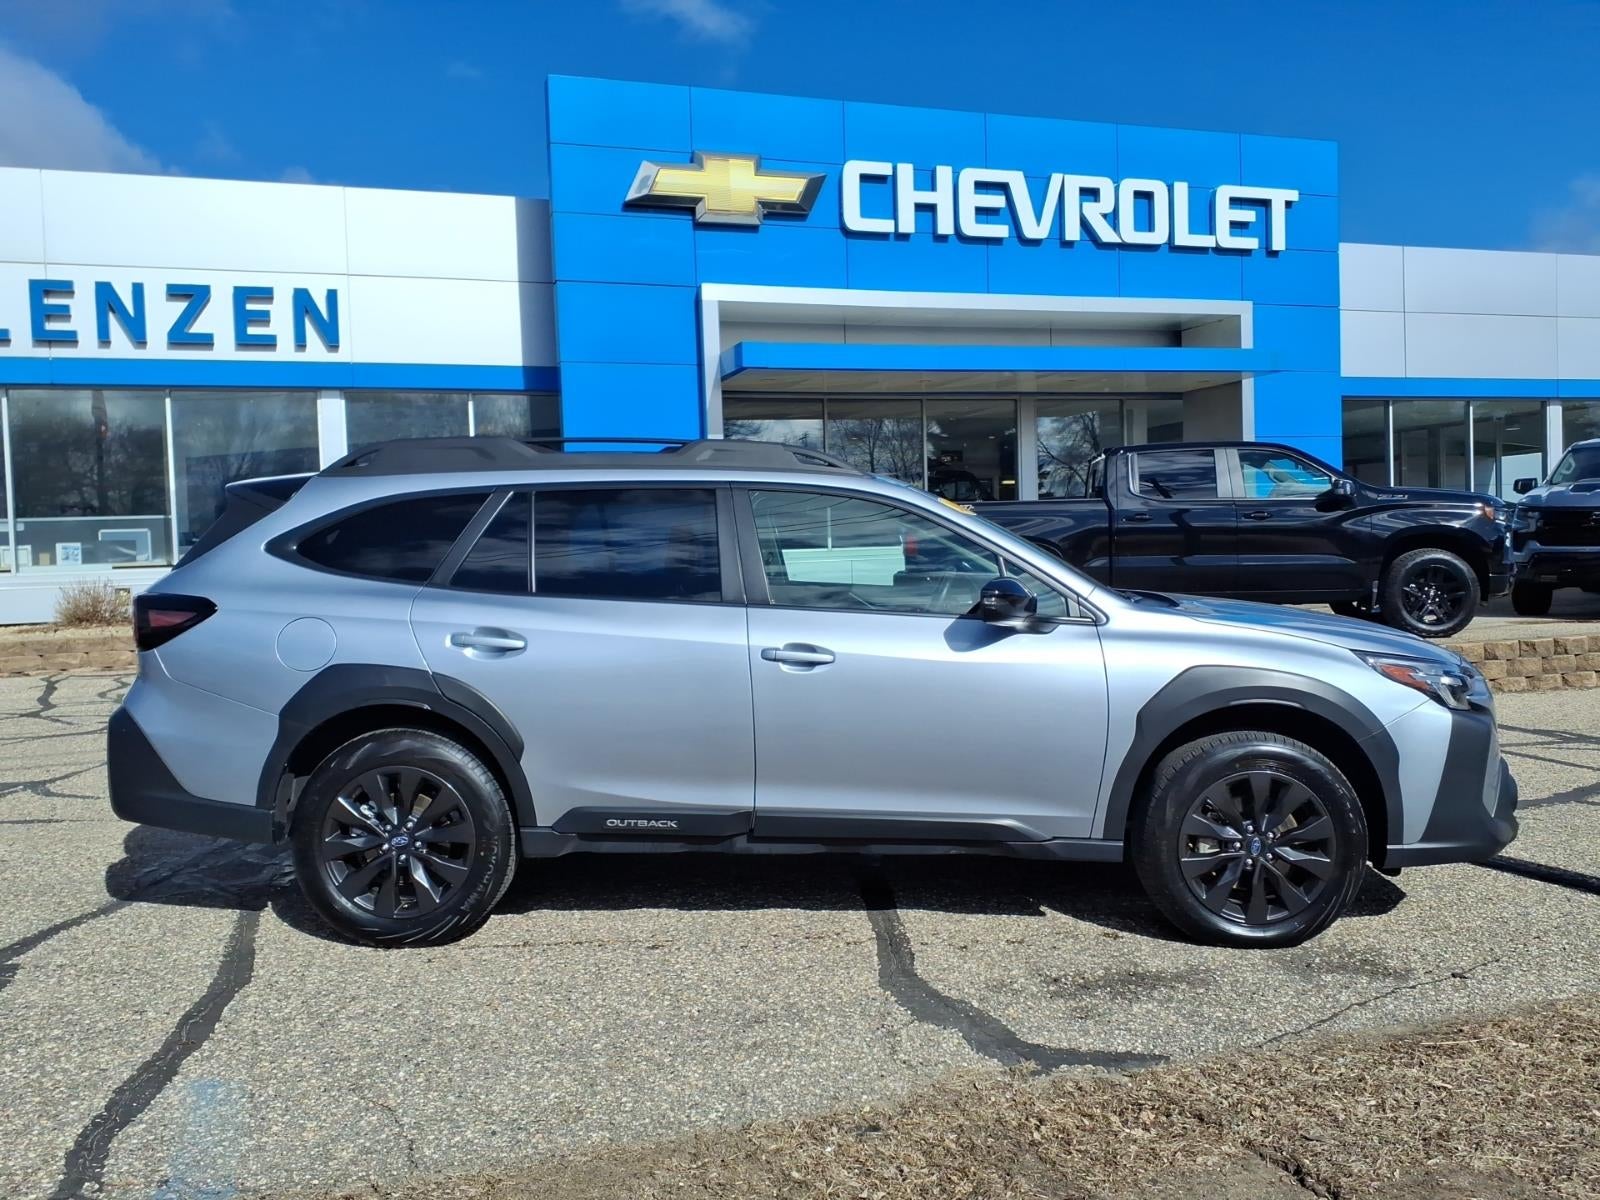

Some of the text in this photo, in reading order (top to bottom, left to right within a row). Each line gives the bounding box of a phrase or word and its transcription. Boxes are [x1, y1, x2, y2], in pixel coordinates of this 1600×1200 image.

[842, 160, 1299, 253] CHEVROLET
[0, 278, 340, 348] ENZEN
[606, 818, 678, 828] OUTBACK
